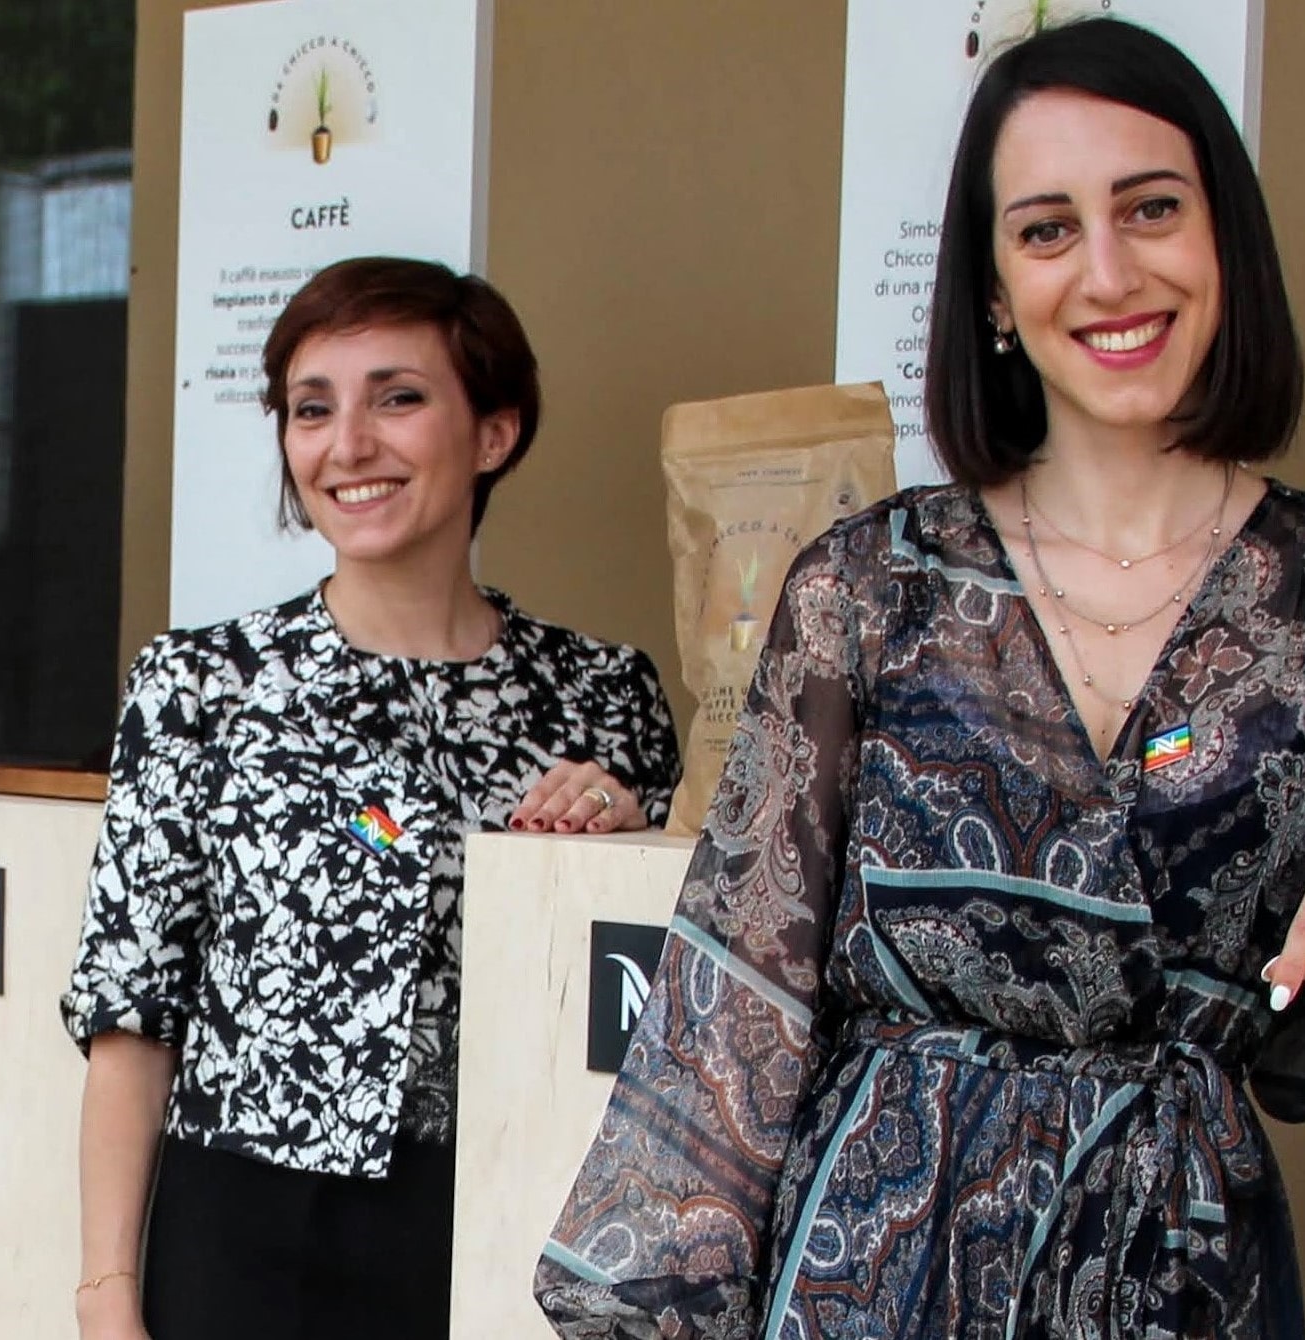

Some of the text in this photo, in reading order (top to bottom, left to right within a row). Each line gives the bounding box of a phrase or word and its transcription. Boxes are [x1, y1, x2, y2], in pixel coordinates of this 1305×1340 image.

[283, 36, 325, 76] CHICCO
[341, 38, 376, 94] CHICCO
[290, 198, 350, 230] CAFFÈ
[883, 249, 934, 268] Chicco
[228, 266, 256, 282] caffè
[875, 279, 889, 296] di
[893, 281, 920, 296] una
[213, 294, 265, 310] impianto
[268, 291, 280, 306] di
[205, 365, 236, 379] risaia
